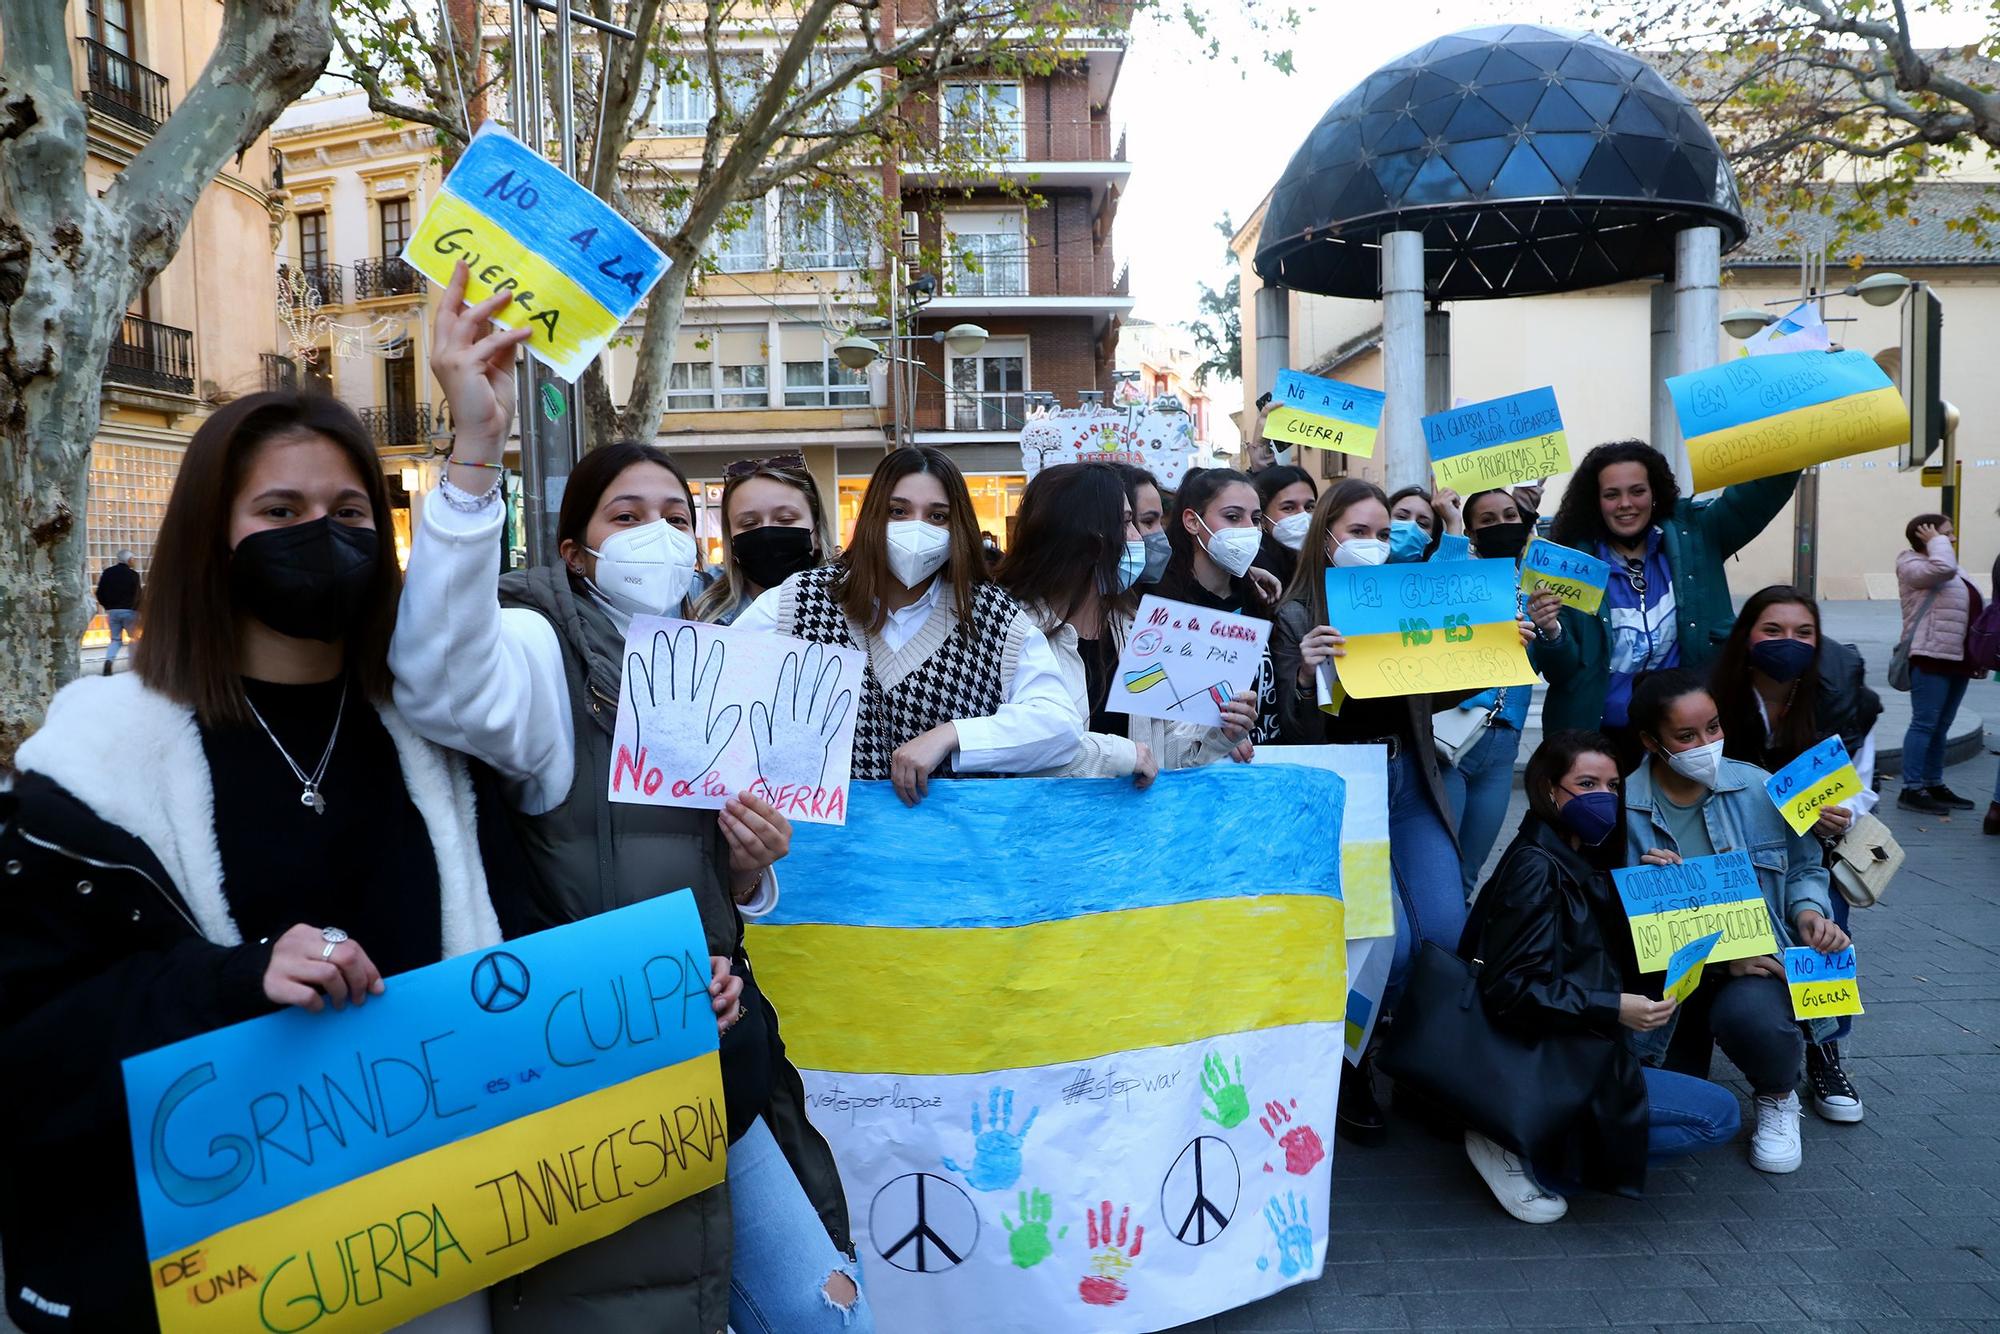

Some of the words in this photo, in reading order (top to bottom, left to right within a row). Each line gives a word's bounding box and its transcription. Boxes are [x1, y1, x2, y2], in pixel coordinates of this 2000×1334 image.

[484, 170, 539, 210] NO
[569, 227, 598, 253] A
[598, 254, 645, 297] LA
[434, 228, 560, 343] GUERRA
[1287, 382, 1305, 400] NO
[1322, 395, 1330, 406] A
[1342, 399, 1353, 410] LA
[1690, 379, 1728, 417] EN
[1727, 363, 1762, 395] LA
[1759, 368, 1828, 409] GUERRA
[1287, 419, 1344, 445] GUERRA
[1430, 421, 1446, 444] LA
[1448, 411, 1486, 437] GUERRA
[1487, 406, 1500, 424] ES
[1507, 401, 1520, 416] LA
[1470, 424, 1506, 447] SALIDA
[1509, 408, 1560, 437] COBARDE
[1075, 451, 1145, 465] LETICIA
[1442, 463, 1452, 481] A
[1455, 454, 1475, 475] LOS
[1477, 447, 1537, 481] PROBLEMAS
[1541, 435, 1556, 449] DE
[1544, 447, 1561, 461] LA
[1509, 461, 1559, 485] PAZ
[1532, 549, 1549, 566] NO
[1560, 561, 1568, 572] A
[1575, 563, 1589, 575] LA
[1350, 572, 1383, 610] LA
[1401, 573, 1493, 609] GUERRA
[1534, 579, 1582, 600] GUERRA
[1172, 616, 1182, 629] a
[1188, 617, 1200, 632] la
[1210, 620, 1257, 643] GUERRA
[1400, 617, 1433, 648] NO
[1443, 613, 1473, 643] ES
[1163, 645, 1173, 654] a
[1180, 641, 1193, 658] la
[1206, 646, 1238, 665] PAZ
[1378, 646, 1518, 692] PROGRESO
[1775, 776, 1794, 798] NO
[1812, 756, 1823, 770] A
[1830, 742, 1844, 757] LA
[672, 780, 696, 798] a
[704, 771, 730, 798] la
[748, 777, 846, 821] GUERRA
[1797, 782, 1844, 819] GUERRA
[1625, 864, 1706, 900] QUEREMOS
[1714, 853, 1747, 870] AVAN
[1716, 869, 1754, 889] ZAR
[1712, 890, 1744, 905] PUTIN
[1637, 925, 1662, 960] NO
[1795, 958, 1814, 975] NO
[1824, 957, 1835, 969] A
[1837, 955, 1856, 970] LA
[1802, 988, 1850, 1008] GUERRA
[150, 1030, 477, 1208] GRANDE
[519, 1066, 544, 1083] LA
[545, 949, 711, 1068] CULPA
[159, 1249, 201, 1284] DE
[193, 1264, 257, 1305] UNA
[260, 1202, 472, 1334] GUERRA
